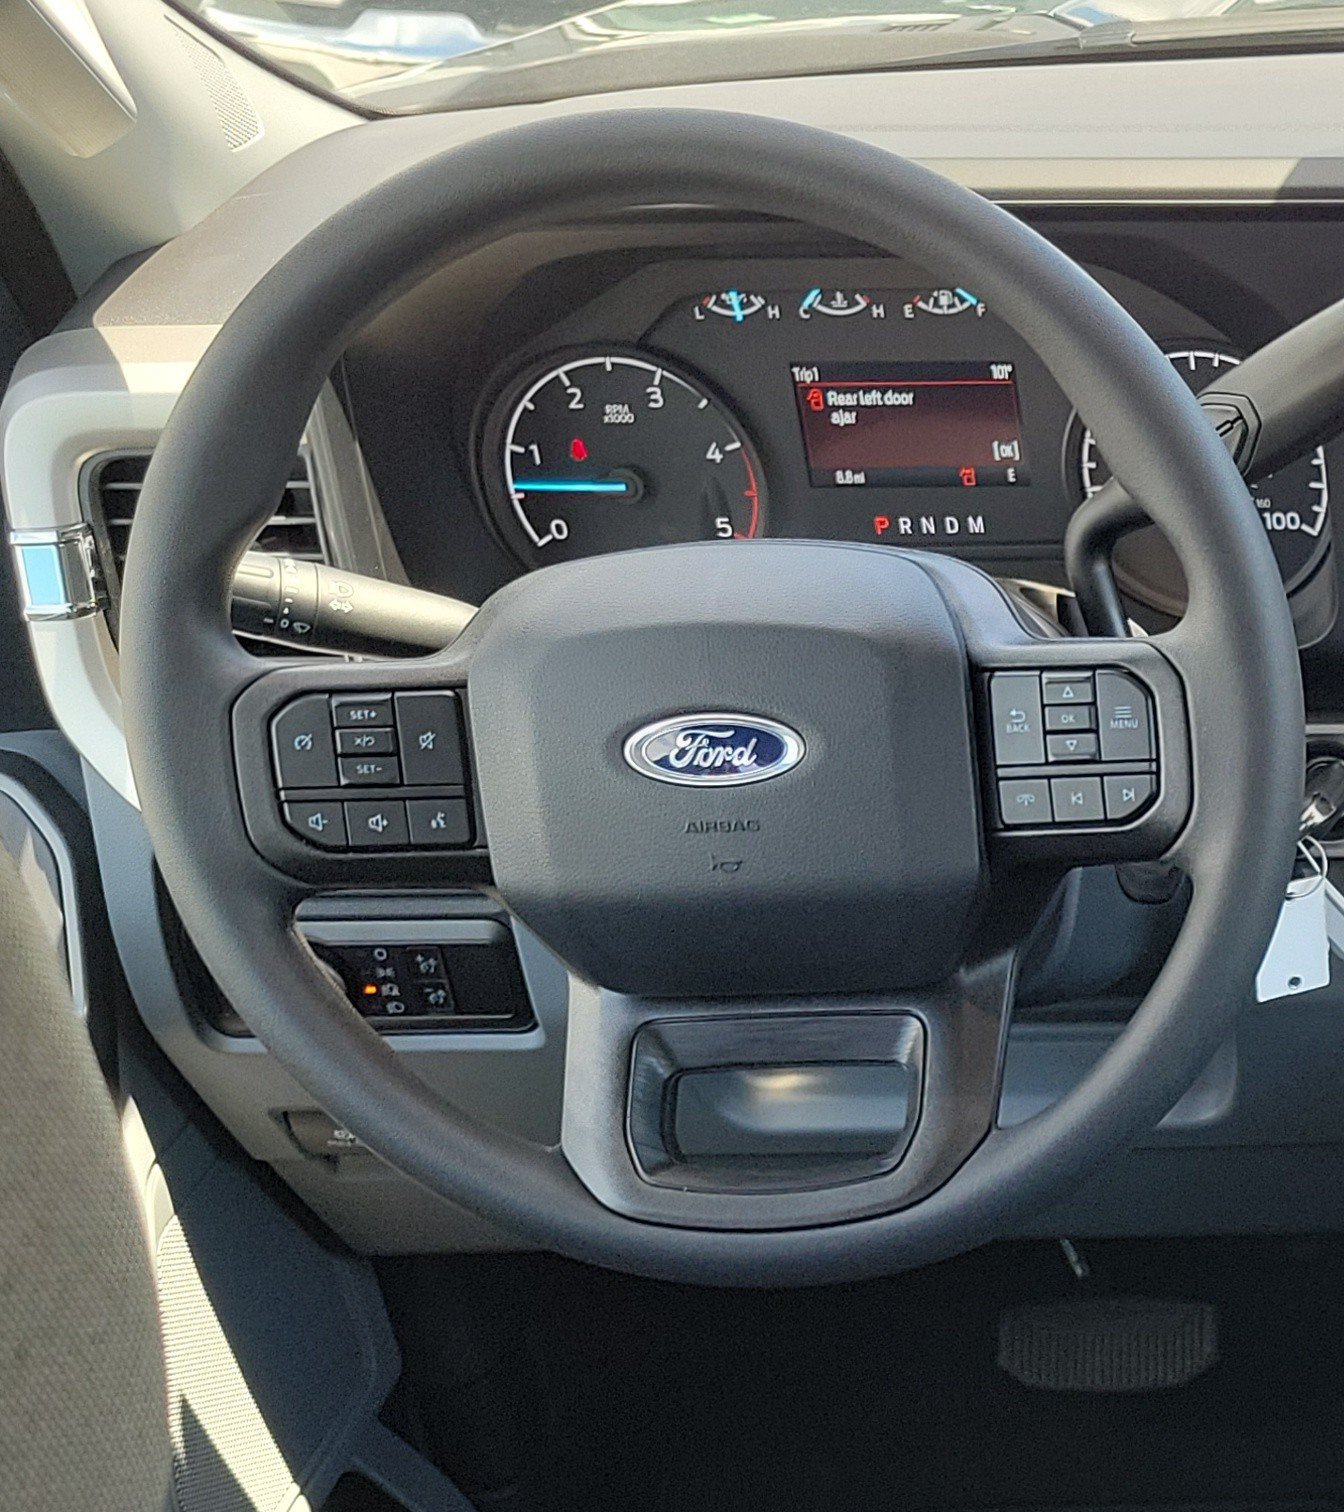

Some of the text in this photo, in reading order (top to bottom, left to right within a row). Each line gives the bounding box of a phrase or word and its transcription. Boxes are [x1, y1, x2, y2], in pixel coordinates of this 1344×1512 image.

[767, 306, 780, 319] H
[872, 306, 885, 318] H
[904, 306, 914, 318] E
[976, 305, 986, 317] F
[566, 387, 584, 408] 2
[646, 387, 664, 408] 3
[827, 390, 914, 406] Rear left door
[831, 411, 857, 426] ajar
[529, 443, 541, 465] 1
[706, 442, 723, 463] 4
[1007, 467, 1016, 482] E
[715, 517, 732, 538] 5
[874, 516, 985, 535] P R N D M
[1262, 511, 1300, 531] 100
[550, 519, 568, 540] 0
[1061, 714, 1075, 723] OK
[1110, 719, 1139, 729] MENU
[1006, 723, 1031, 734] BACK
[668, 729, 758, 768] Ford
[685, 820, 760, 834] AIRBAG
